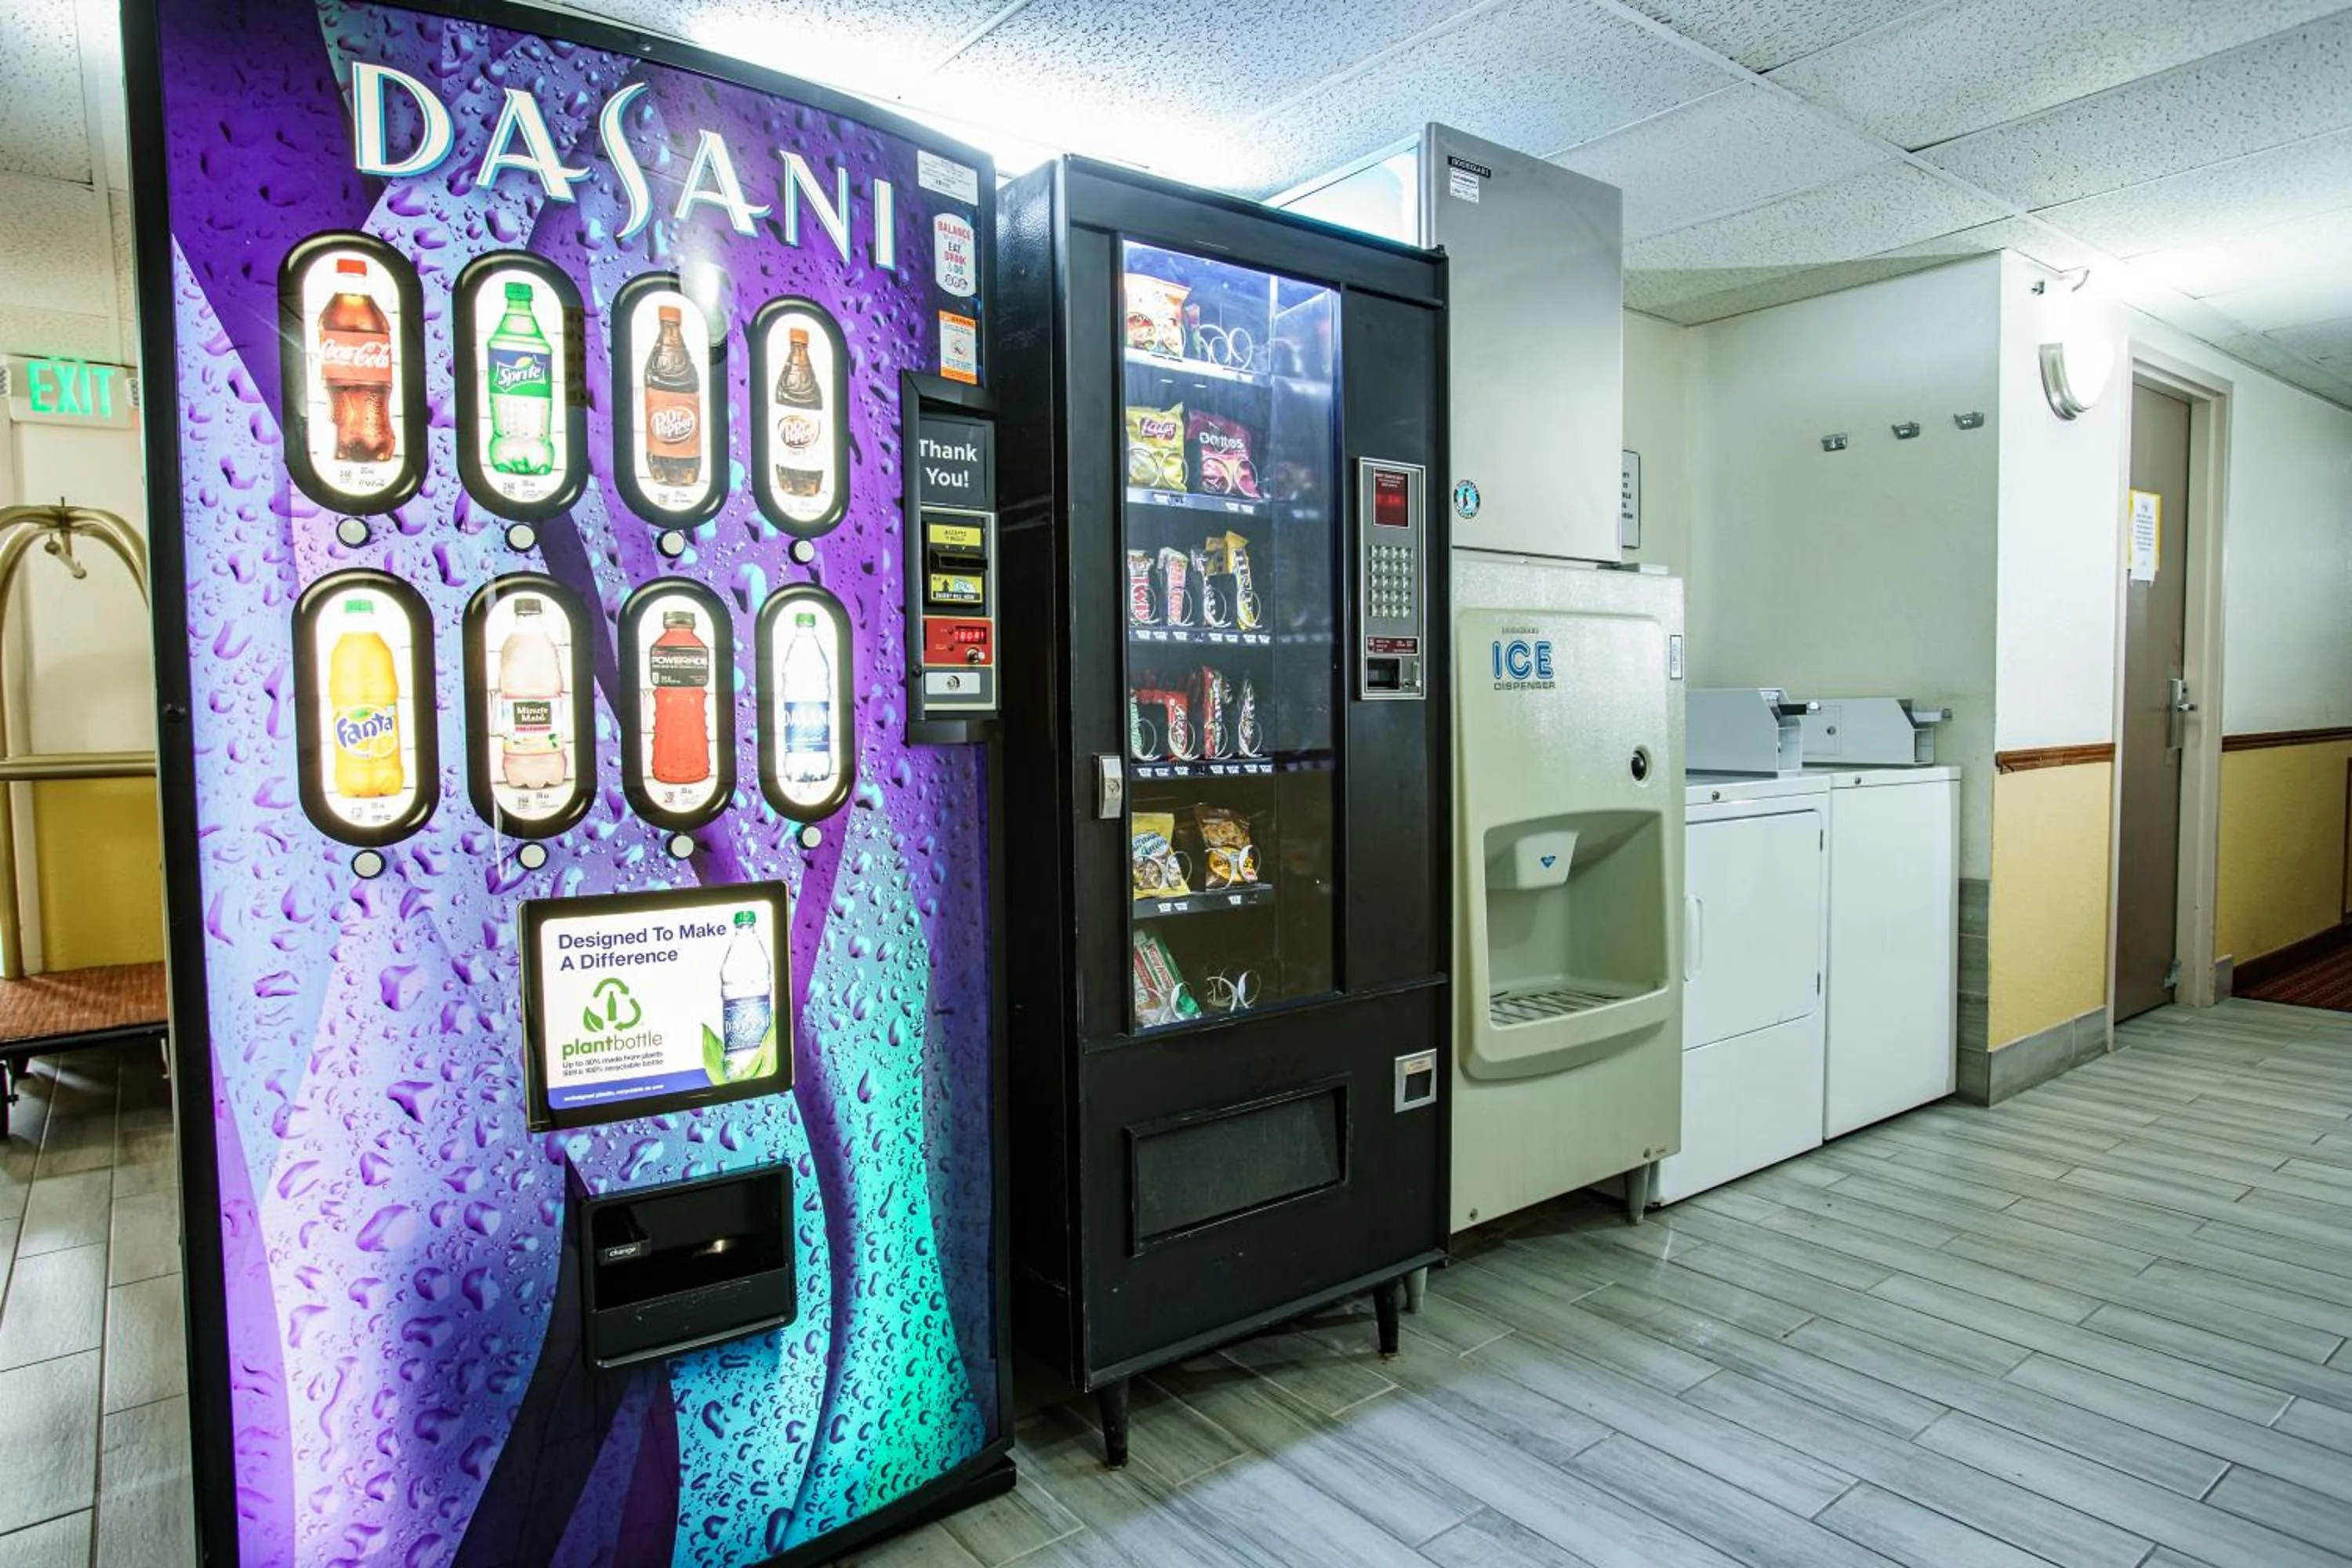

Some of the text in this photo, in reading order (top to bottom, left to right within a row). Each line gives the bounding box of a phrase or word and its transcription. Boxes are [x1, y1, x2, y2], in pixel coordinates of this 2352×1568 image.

[351, 61, 898, 272] DASANI
[938, 220, 971, 241] BALANCE
[498, 365, 542, 387] Sprite
[27, 360, 115, 418] EXIT
[652, 412, 693, 437] Pepper
[919, 438, 978, 462] Thank
[1199, 431, 1244, 450] Doritos
[925, 466, 970, 488] You!
[1493, 640, 1554, 680] ICE
[1494, 681, 1556, 691] DISPENSER
[336, 713, 394, 747] Fanta
[558, 922, 727, 949] Designed To Make
[560, 949, 678, 971] A Difference
[561, 1030, 663, 1060] plantbottle
